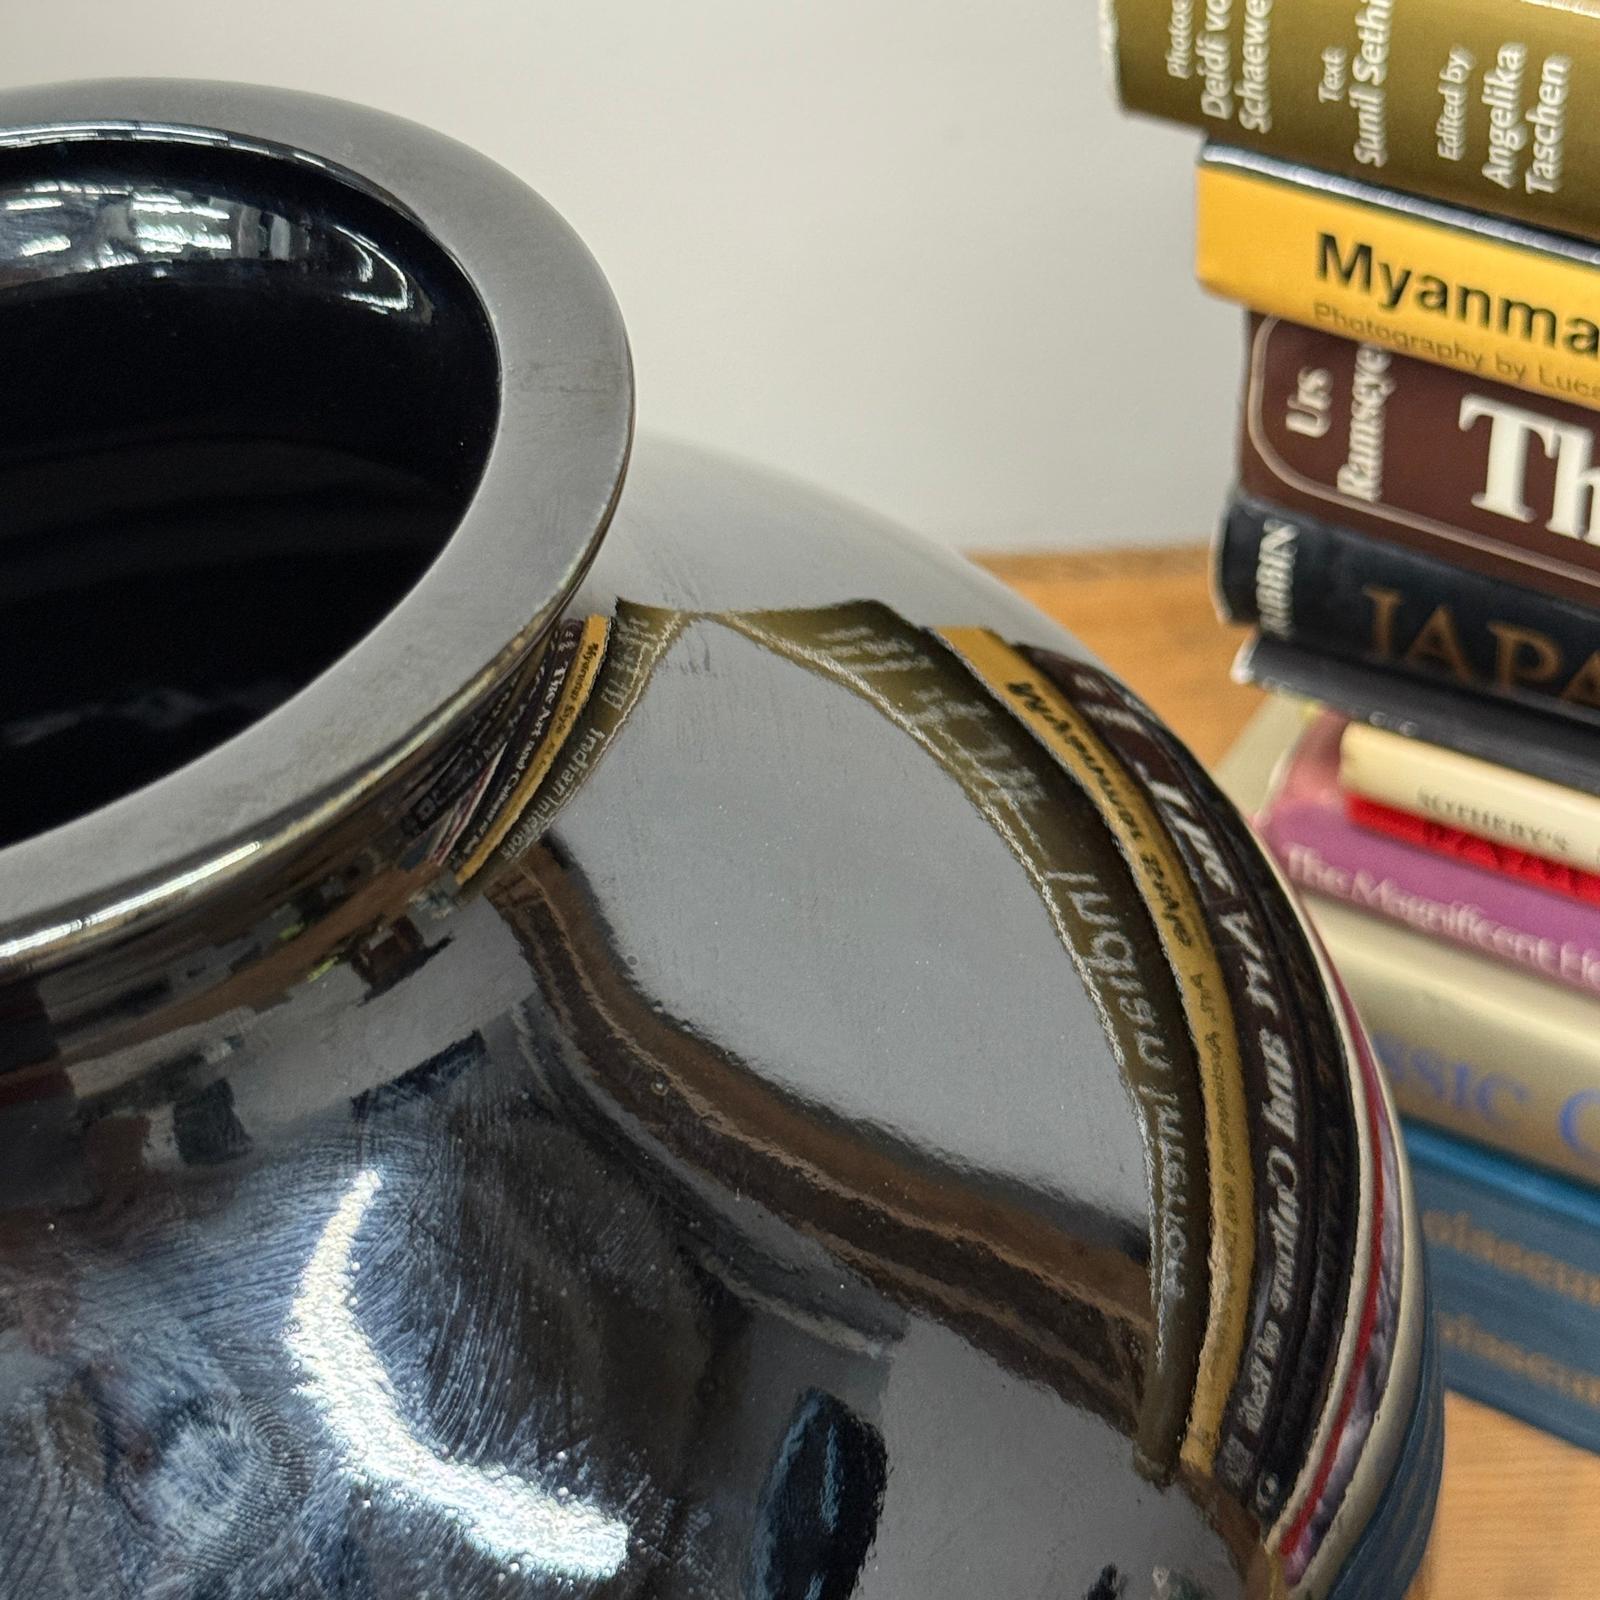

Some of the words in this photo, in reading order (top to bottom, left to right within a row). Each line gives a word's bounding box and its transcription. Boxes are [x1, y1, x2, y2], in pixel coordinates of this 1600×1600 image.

[1196, 31, 1232, 119] Deidi
[1319, 46, 1348, 104] Text
[1440, 45, 1476, 80] by
[1349, 86, 1388, 167] Sunil
[1437, 80, 1470, 160] Edited
[1482, 42, 1527, 188] Angelika
[1526, 54, 1572, 194] Taschen
[1316, 231, 1600, 361] Myanma
[1313, 303, 1485, 371] Photography
[1496, 352, 1526, 384] by
[1285, 367, 1334, 438] Urs
[553, 727, 606, 796] Indian
[500, 795, 562, 862] Interiors
[1283, 842, 1350, 894] The
[1351, 868, 1557, 972] Magnificent
